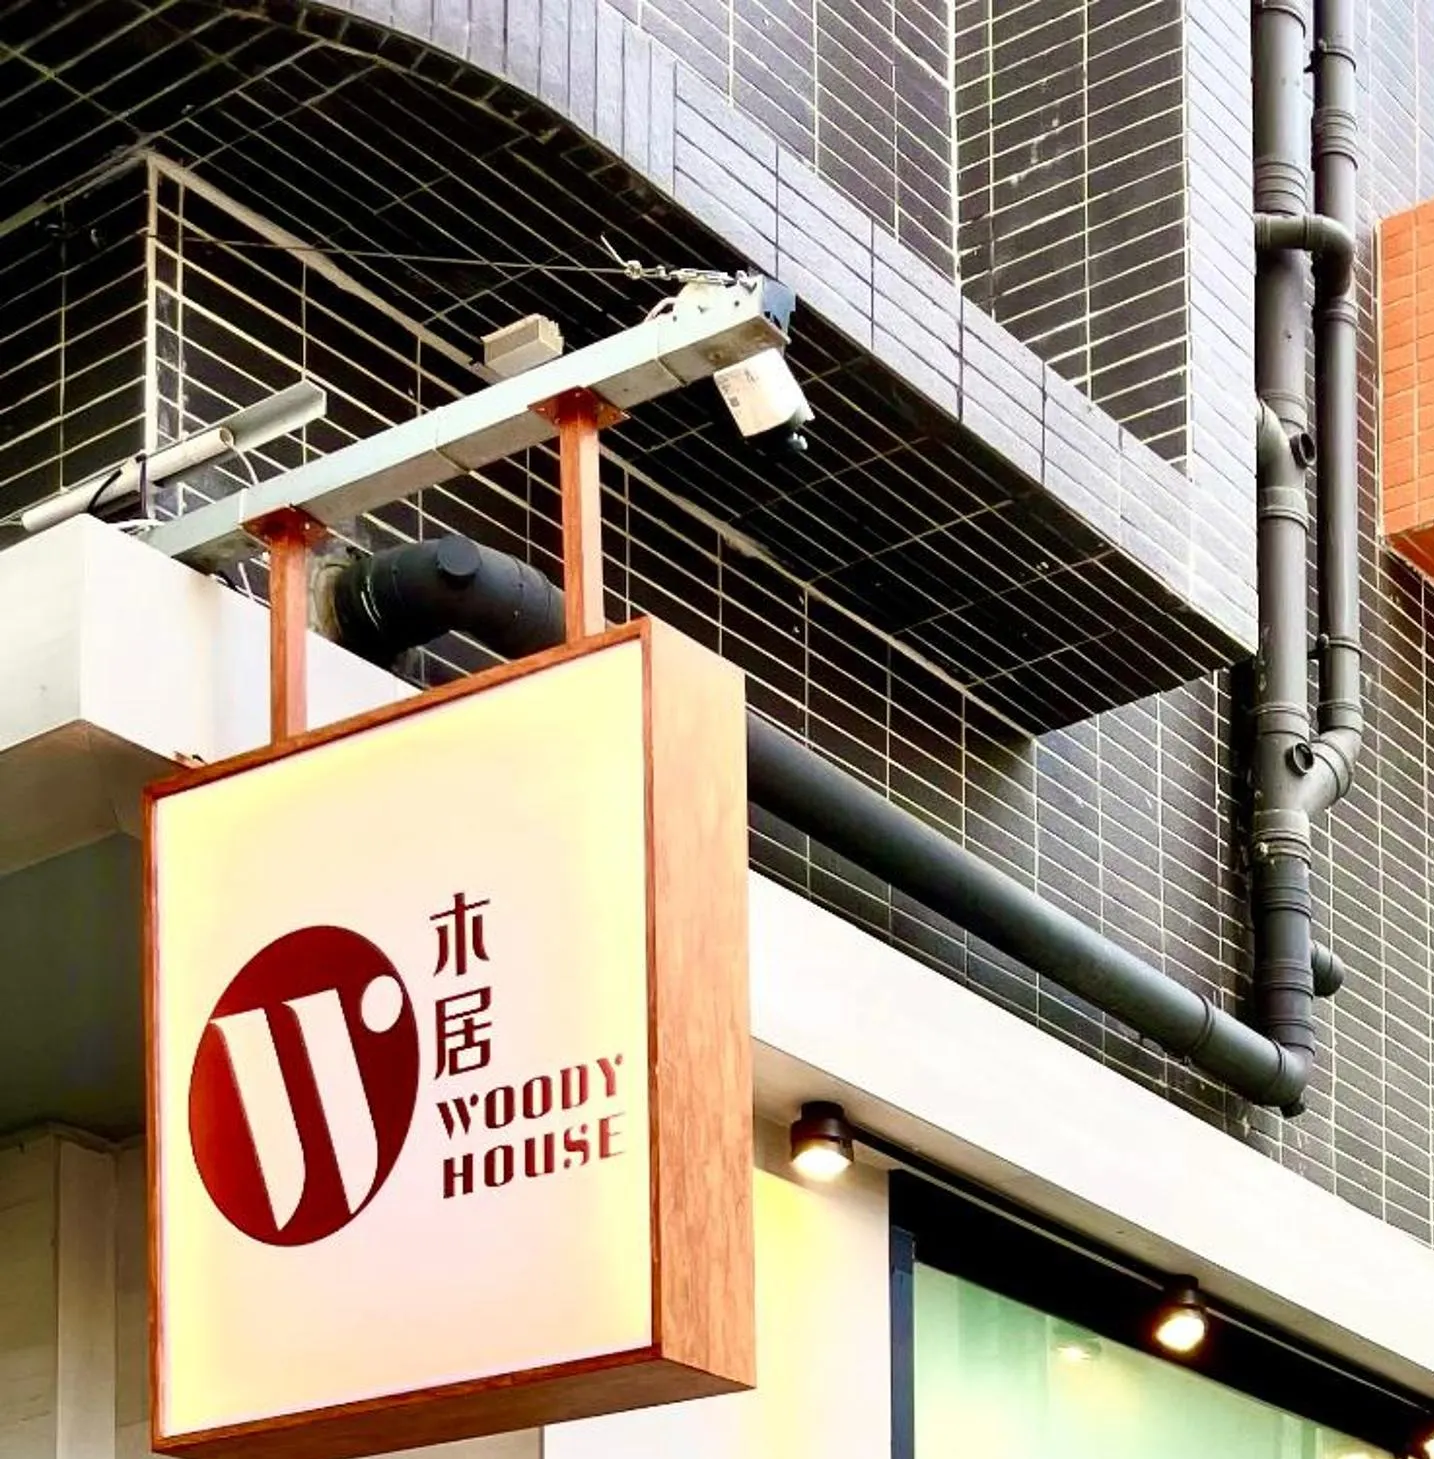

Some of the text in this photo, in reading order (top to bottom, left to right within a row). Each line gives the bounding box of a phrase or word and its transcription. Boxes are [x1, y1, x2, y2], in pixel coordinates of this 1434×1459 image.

[429, 891, 492, 1081] 木居
[436, 1053, 624, 1141] WOODY
[442, 1111, 626, 1199] HOUSE
